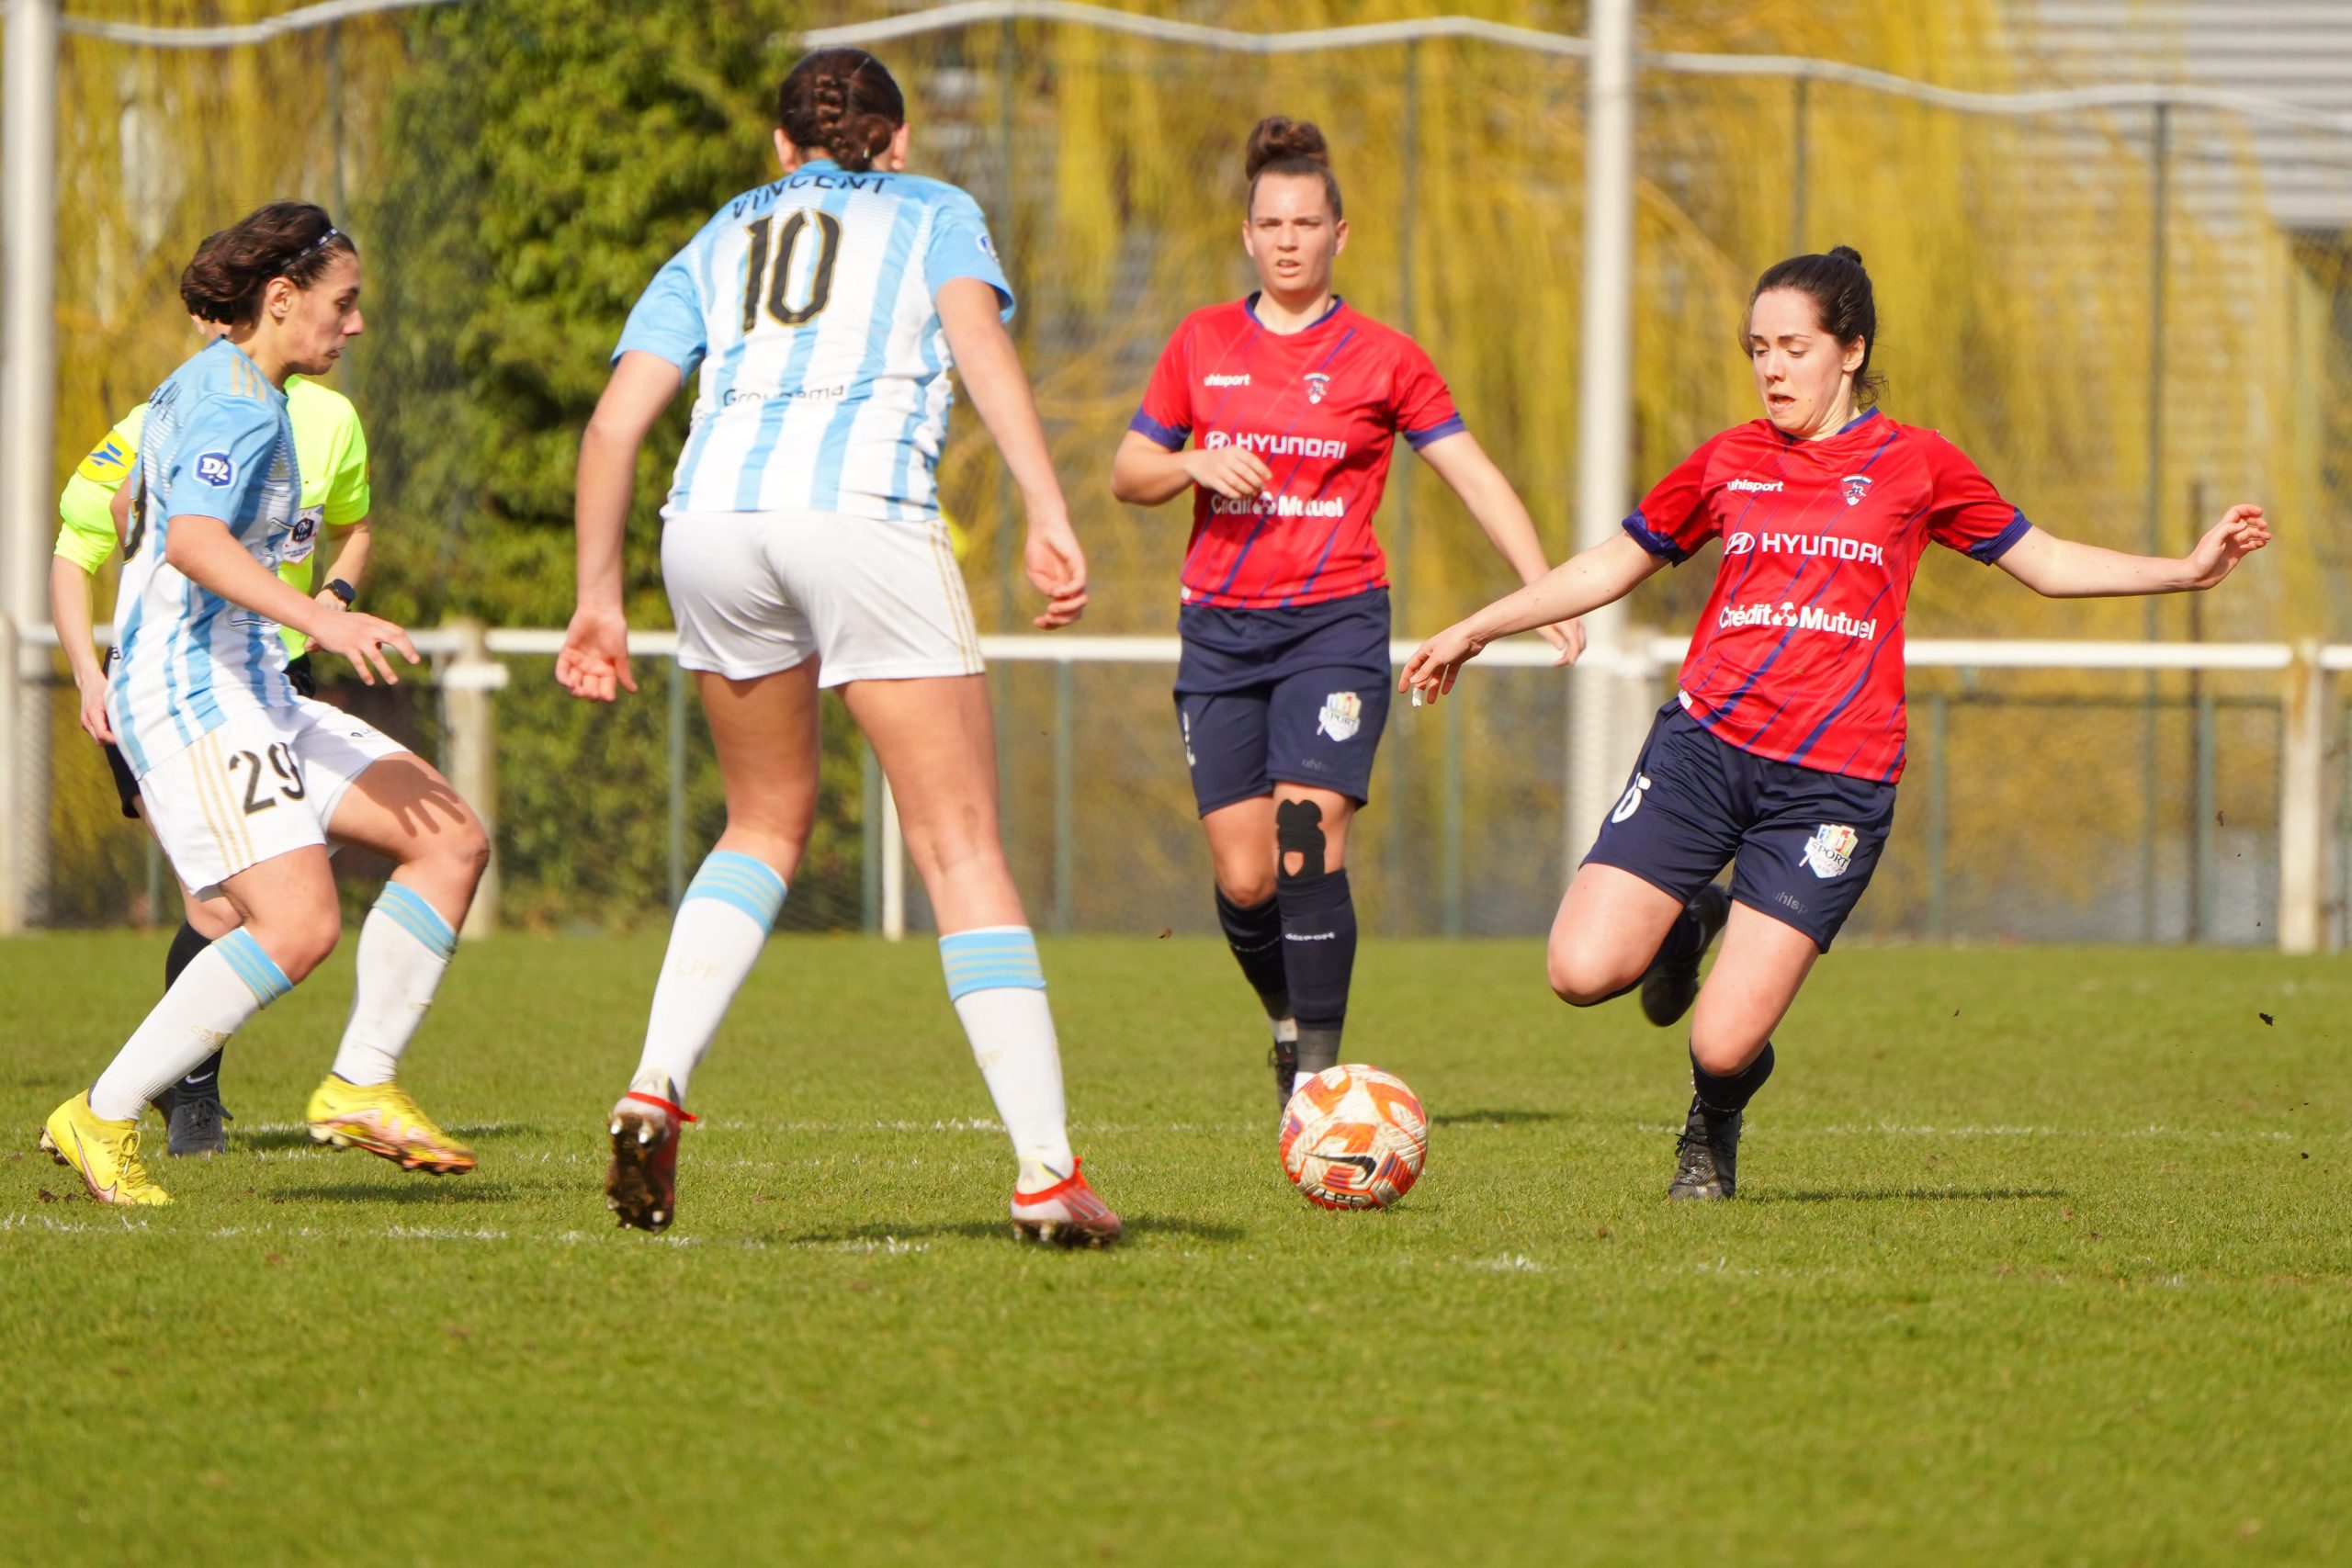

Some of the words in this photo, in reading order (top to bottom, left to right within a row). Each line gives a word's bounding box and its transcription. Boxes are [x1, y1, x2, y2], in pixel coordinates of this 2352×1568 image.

[744, 208, 842, 334] 10
[1237, 433, 1348, 459] HYUNDAI
[1727, 479, 1784, 493] uhlsport
[1761, 532, 1883, 567] HYUNDAI
[1719, 604, 1772, 629] Crédit
[1799, 605, 1877, 641] Mutuel
[229, 741, 305, 817] 29
